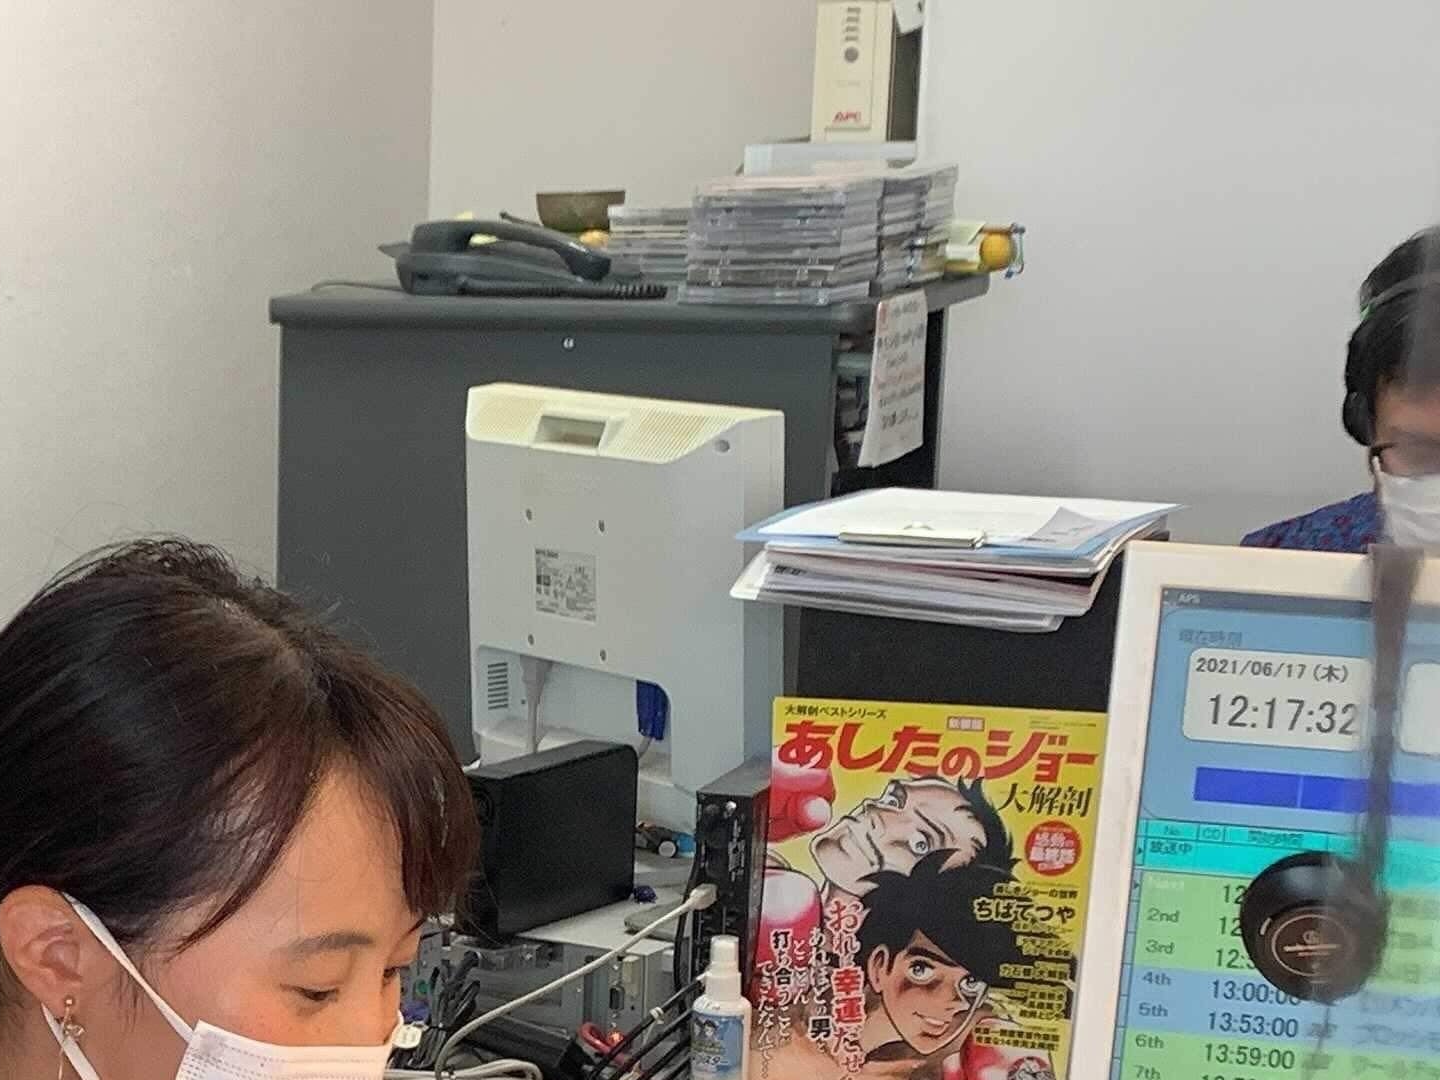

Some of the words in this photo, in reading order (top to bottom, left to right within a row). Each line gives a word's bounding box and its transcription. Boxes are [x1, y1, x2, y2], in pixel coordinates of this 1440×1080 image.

[1195, 657, 1307, 680] 2021/06/17
[1209, 693, 1360, 736] 12:17:32
[777, 719, 1099, 783] あしたのジョー
[999, 783, 1094, 818] 大解剖
[976, 900, 1076, 924] ちばてつや
[1147, 906, 1180, 923] 2nd
[1145, 939, 1175, 955] 3rd
[1141, 971, 1172, 987] 4th
[1138, 1002, 1168, 1018] 5th
[1208, 1012, 1299, 1038] 13:53:00
[1135, 1034, 1164, 1050] 6th
[1204, 1043, 1296, 1070] 13:59:00
[1135, 1065, 1161, 1080] 7th
